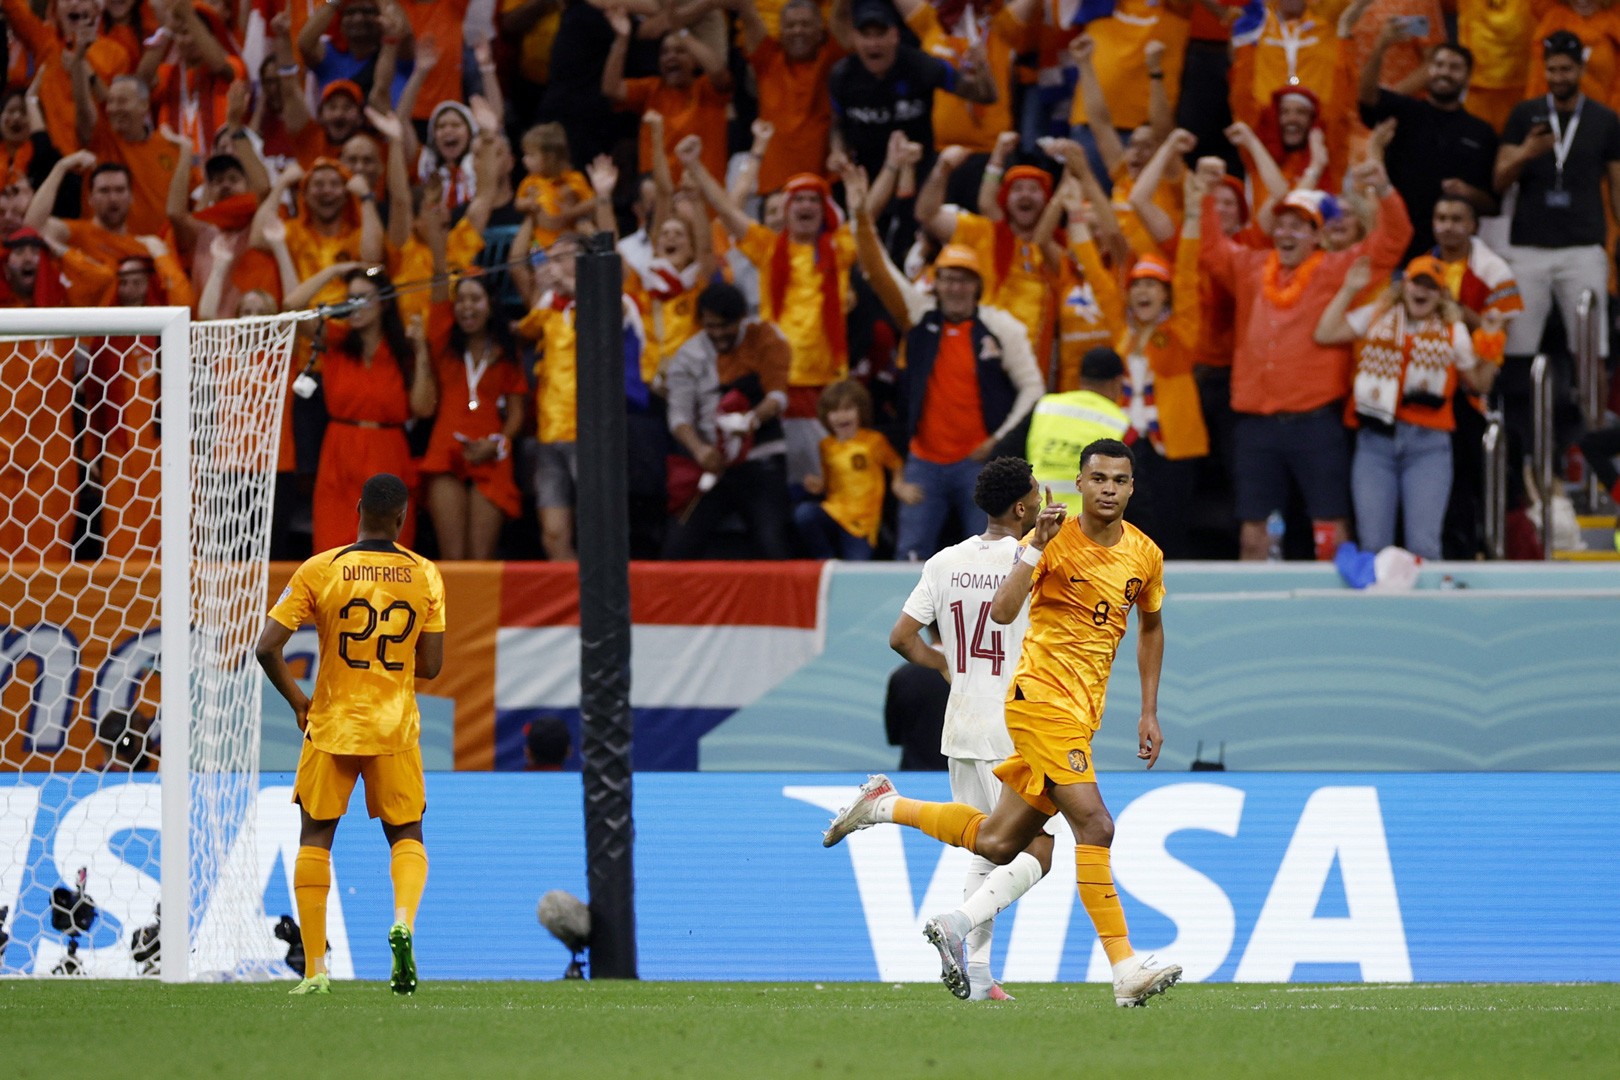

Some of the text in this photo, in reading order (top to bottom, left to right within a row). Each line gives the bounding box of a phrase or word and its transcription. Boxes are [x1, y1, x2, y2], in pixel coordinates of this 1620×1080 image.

[343, 565, 412, 583] DUMFRIES
[339, 598, 416, 671] 22
[950, 600, 1005, 676] 14
[1092, 600, 1110, 626] 8
[783, 782, 1413, 982] VISA
